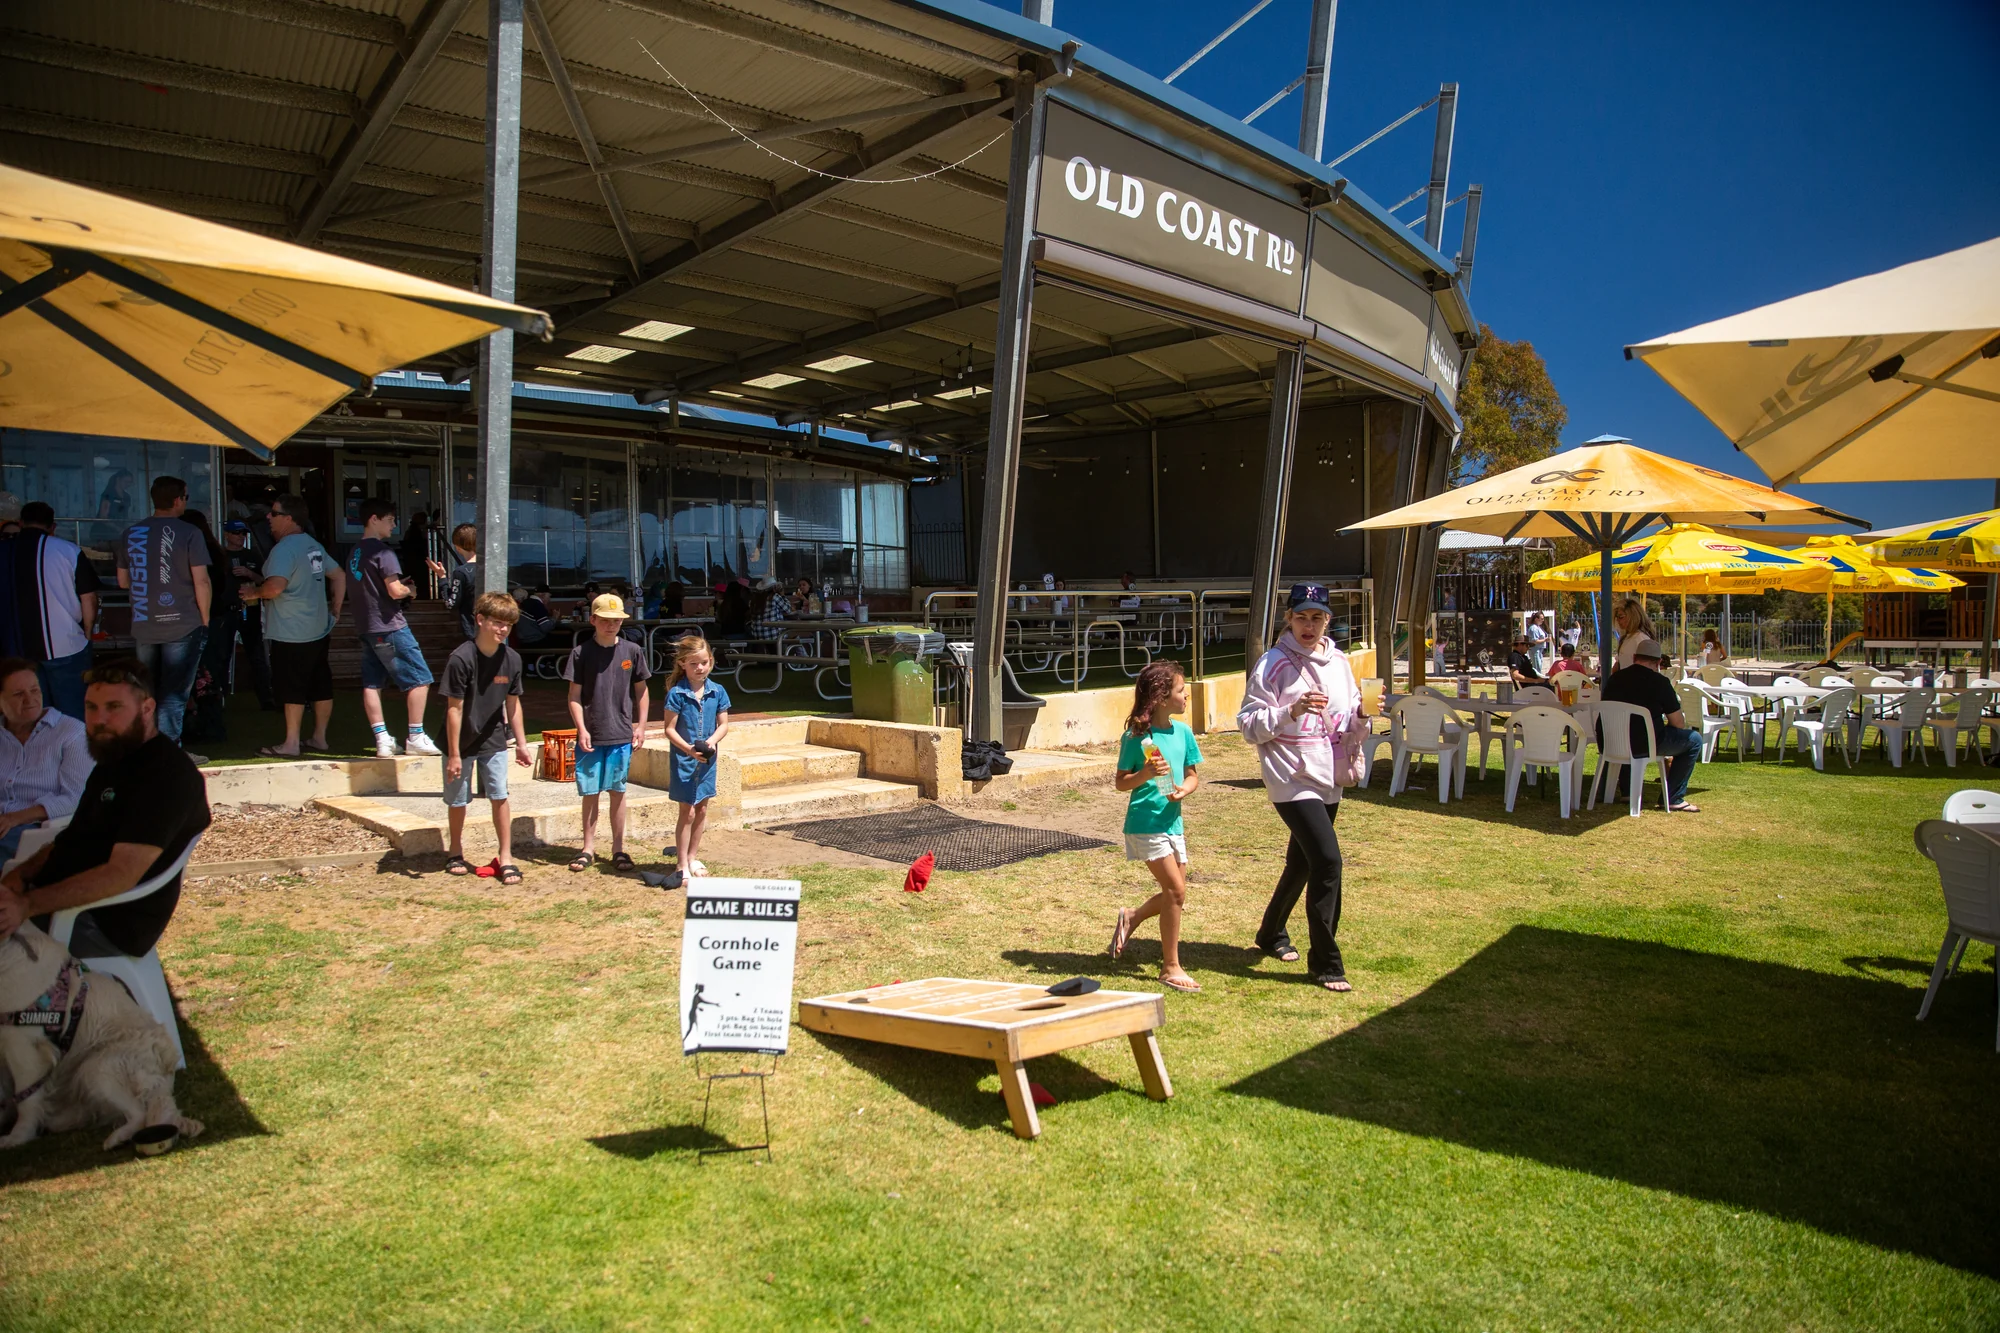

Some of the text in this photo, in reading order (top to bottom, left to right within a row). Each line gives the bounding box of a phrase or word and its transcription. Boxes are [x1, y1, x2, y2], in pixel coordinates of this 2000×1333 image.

[1065, 156, 1145, 219] OLD
[1156, 191, 1260, 262] COAST
[1466, 487, 1645, 506] OLD COAST RD
[690, 900, 795, 917] GAME RULES
[698, 936, 780, 952] Cornhole
[712, 956, 763, 971] Game
[19, 1011, 61, 1024] SUMMER
[741, 1015, 755, 1023] Bag
[766, 1015, 783, 1023] hole
